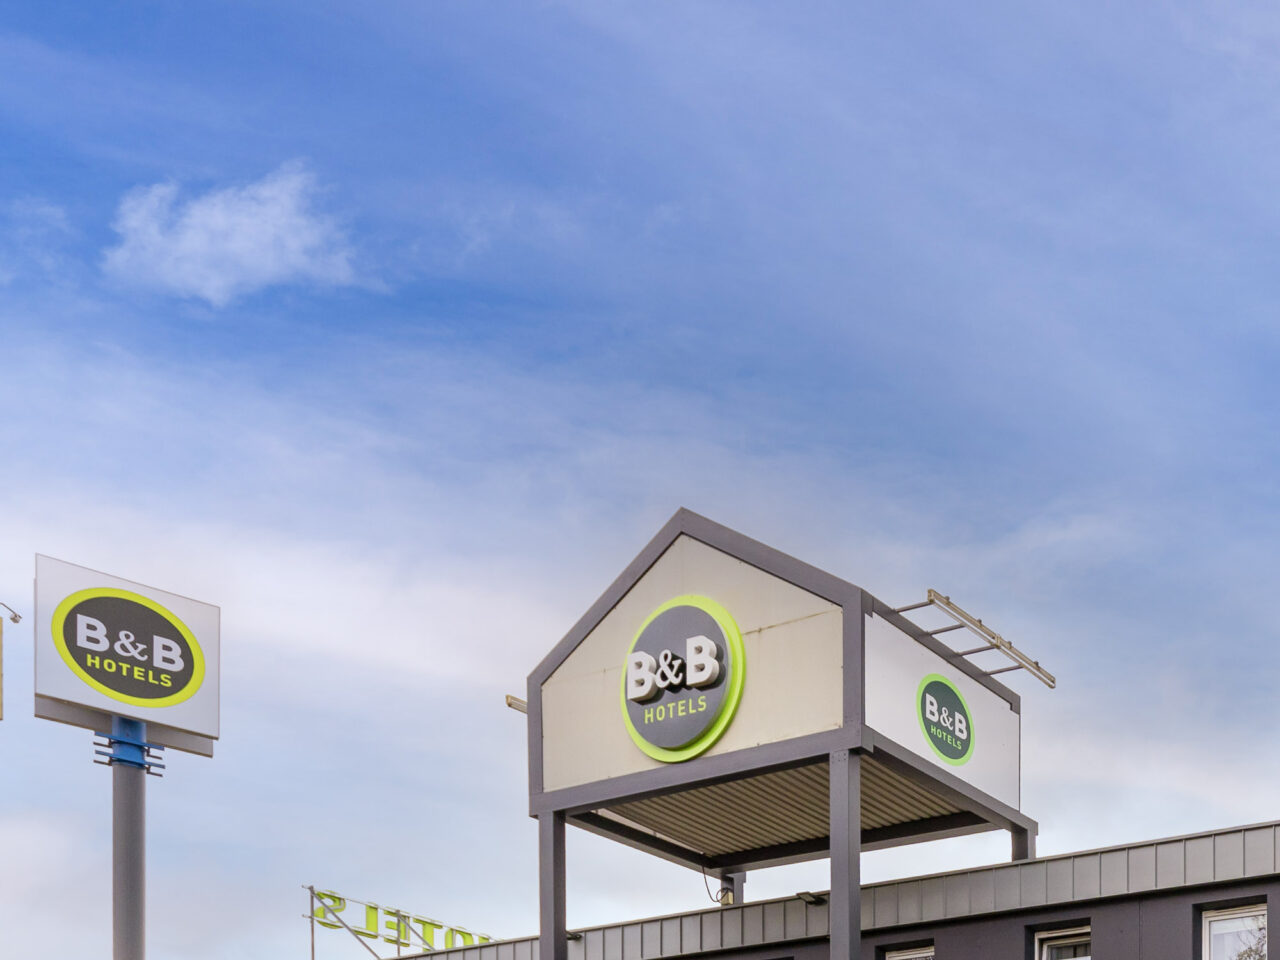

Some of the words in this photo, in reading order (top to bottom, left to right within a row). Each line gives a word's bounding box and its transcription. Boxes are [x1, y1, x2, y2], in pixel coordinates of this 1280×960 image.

[76, 613, 185, 672] B&B
[86, 653, 173, 688] HOTELS
[627, 635, 720, 702] B&B
[644, 696, 707, 724] HOTELS
[925, 692, 967, 740] B&B
[930, 724, 962, 750] HOTELS
